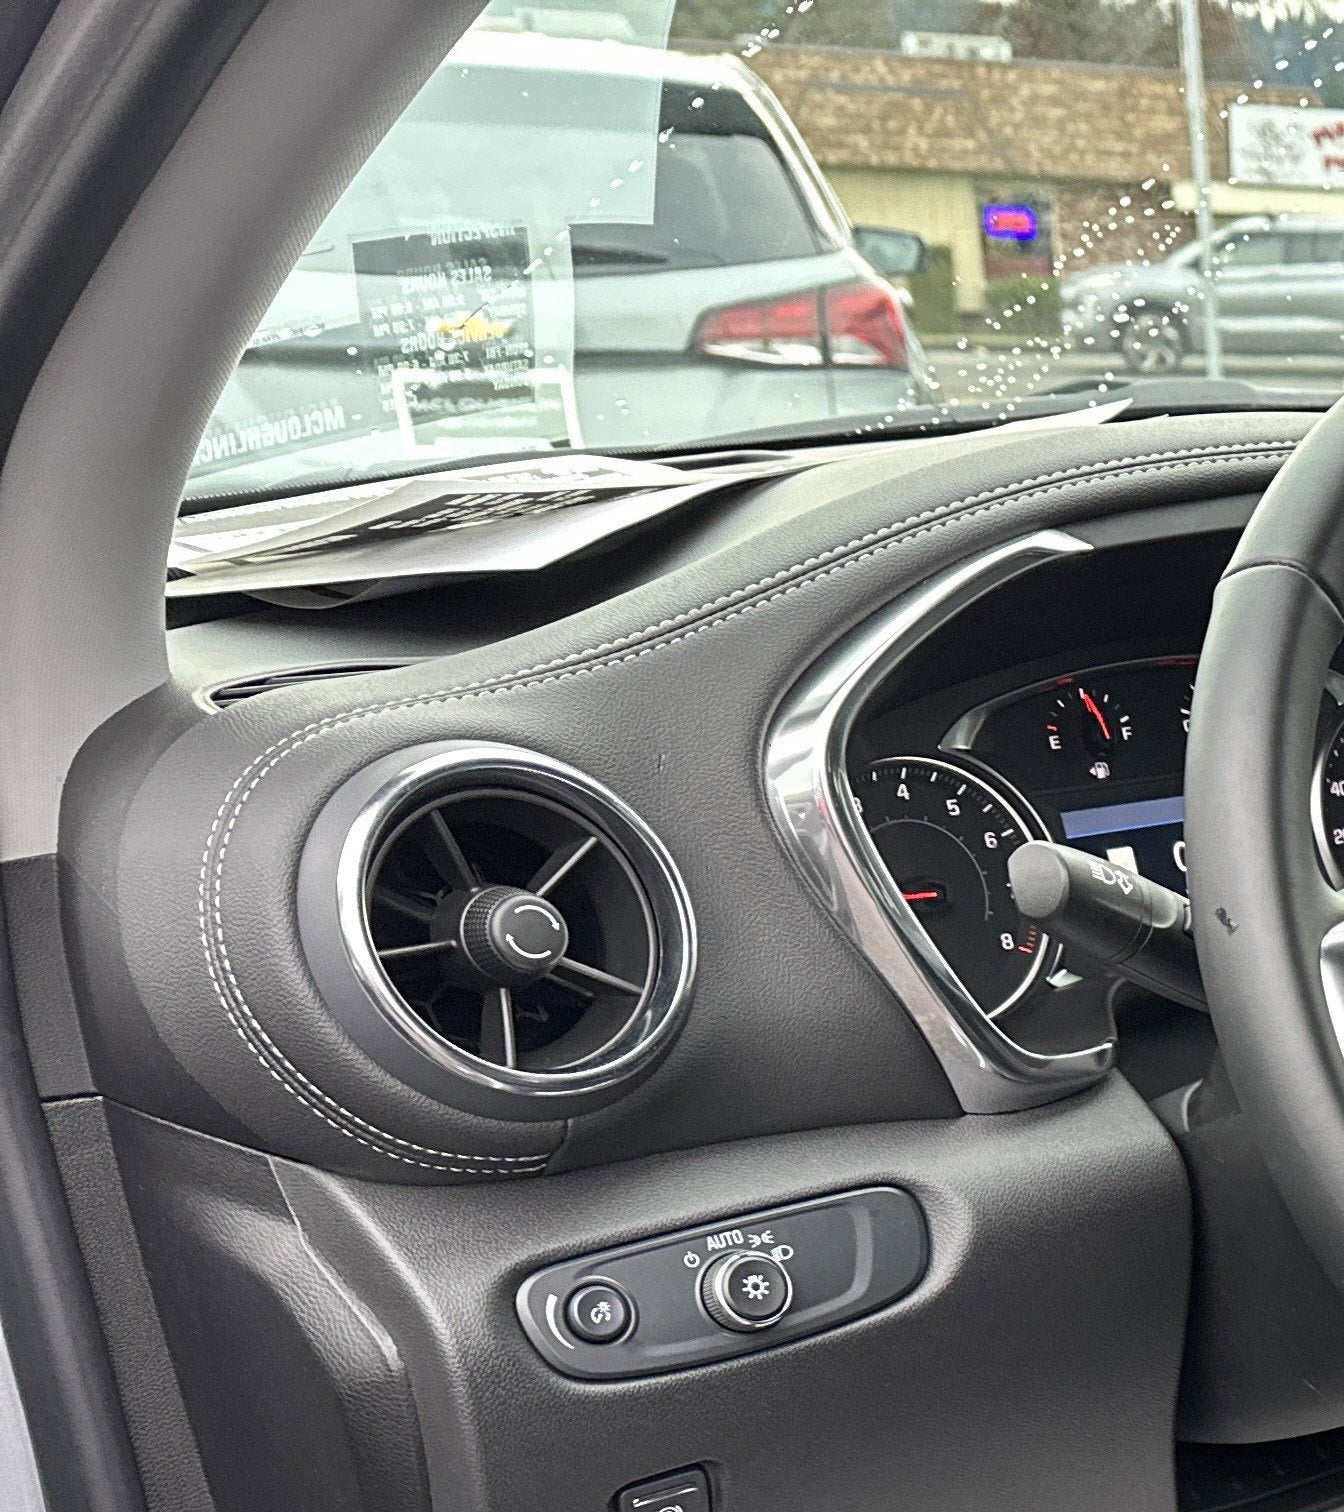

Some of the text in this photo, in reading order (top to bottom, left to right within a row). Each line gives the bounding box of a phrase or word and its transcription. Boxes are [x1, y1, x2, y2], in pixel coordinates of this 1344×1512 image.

[1049, 735, 1062, 750] E
[1121, 727, 1133, 741] F
[896, 783, 910, 800] 4
[946, 799, 961, 817] 5
[984, 832, 998, 849] 6
[1001, 933, 1014, 950] 8
[706, 1229, 744, 1251] AUTO
